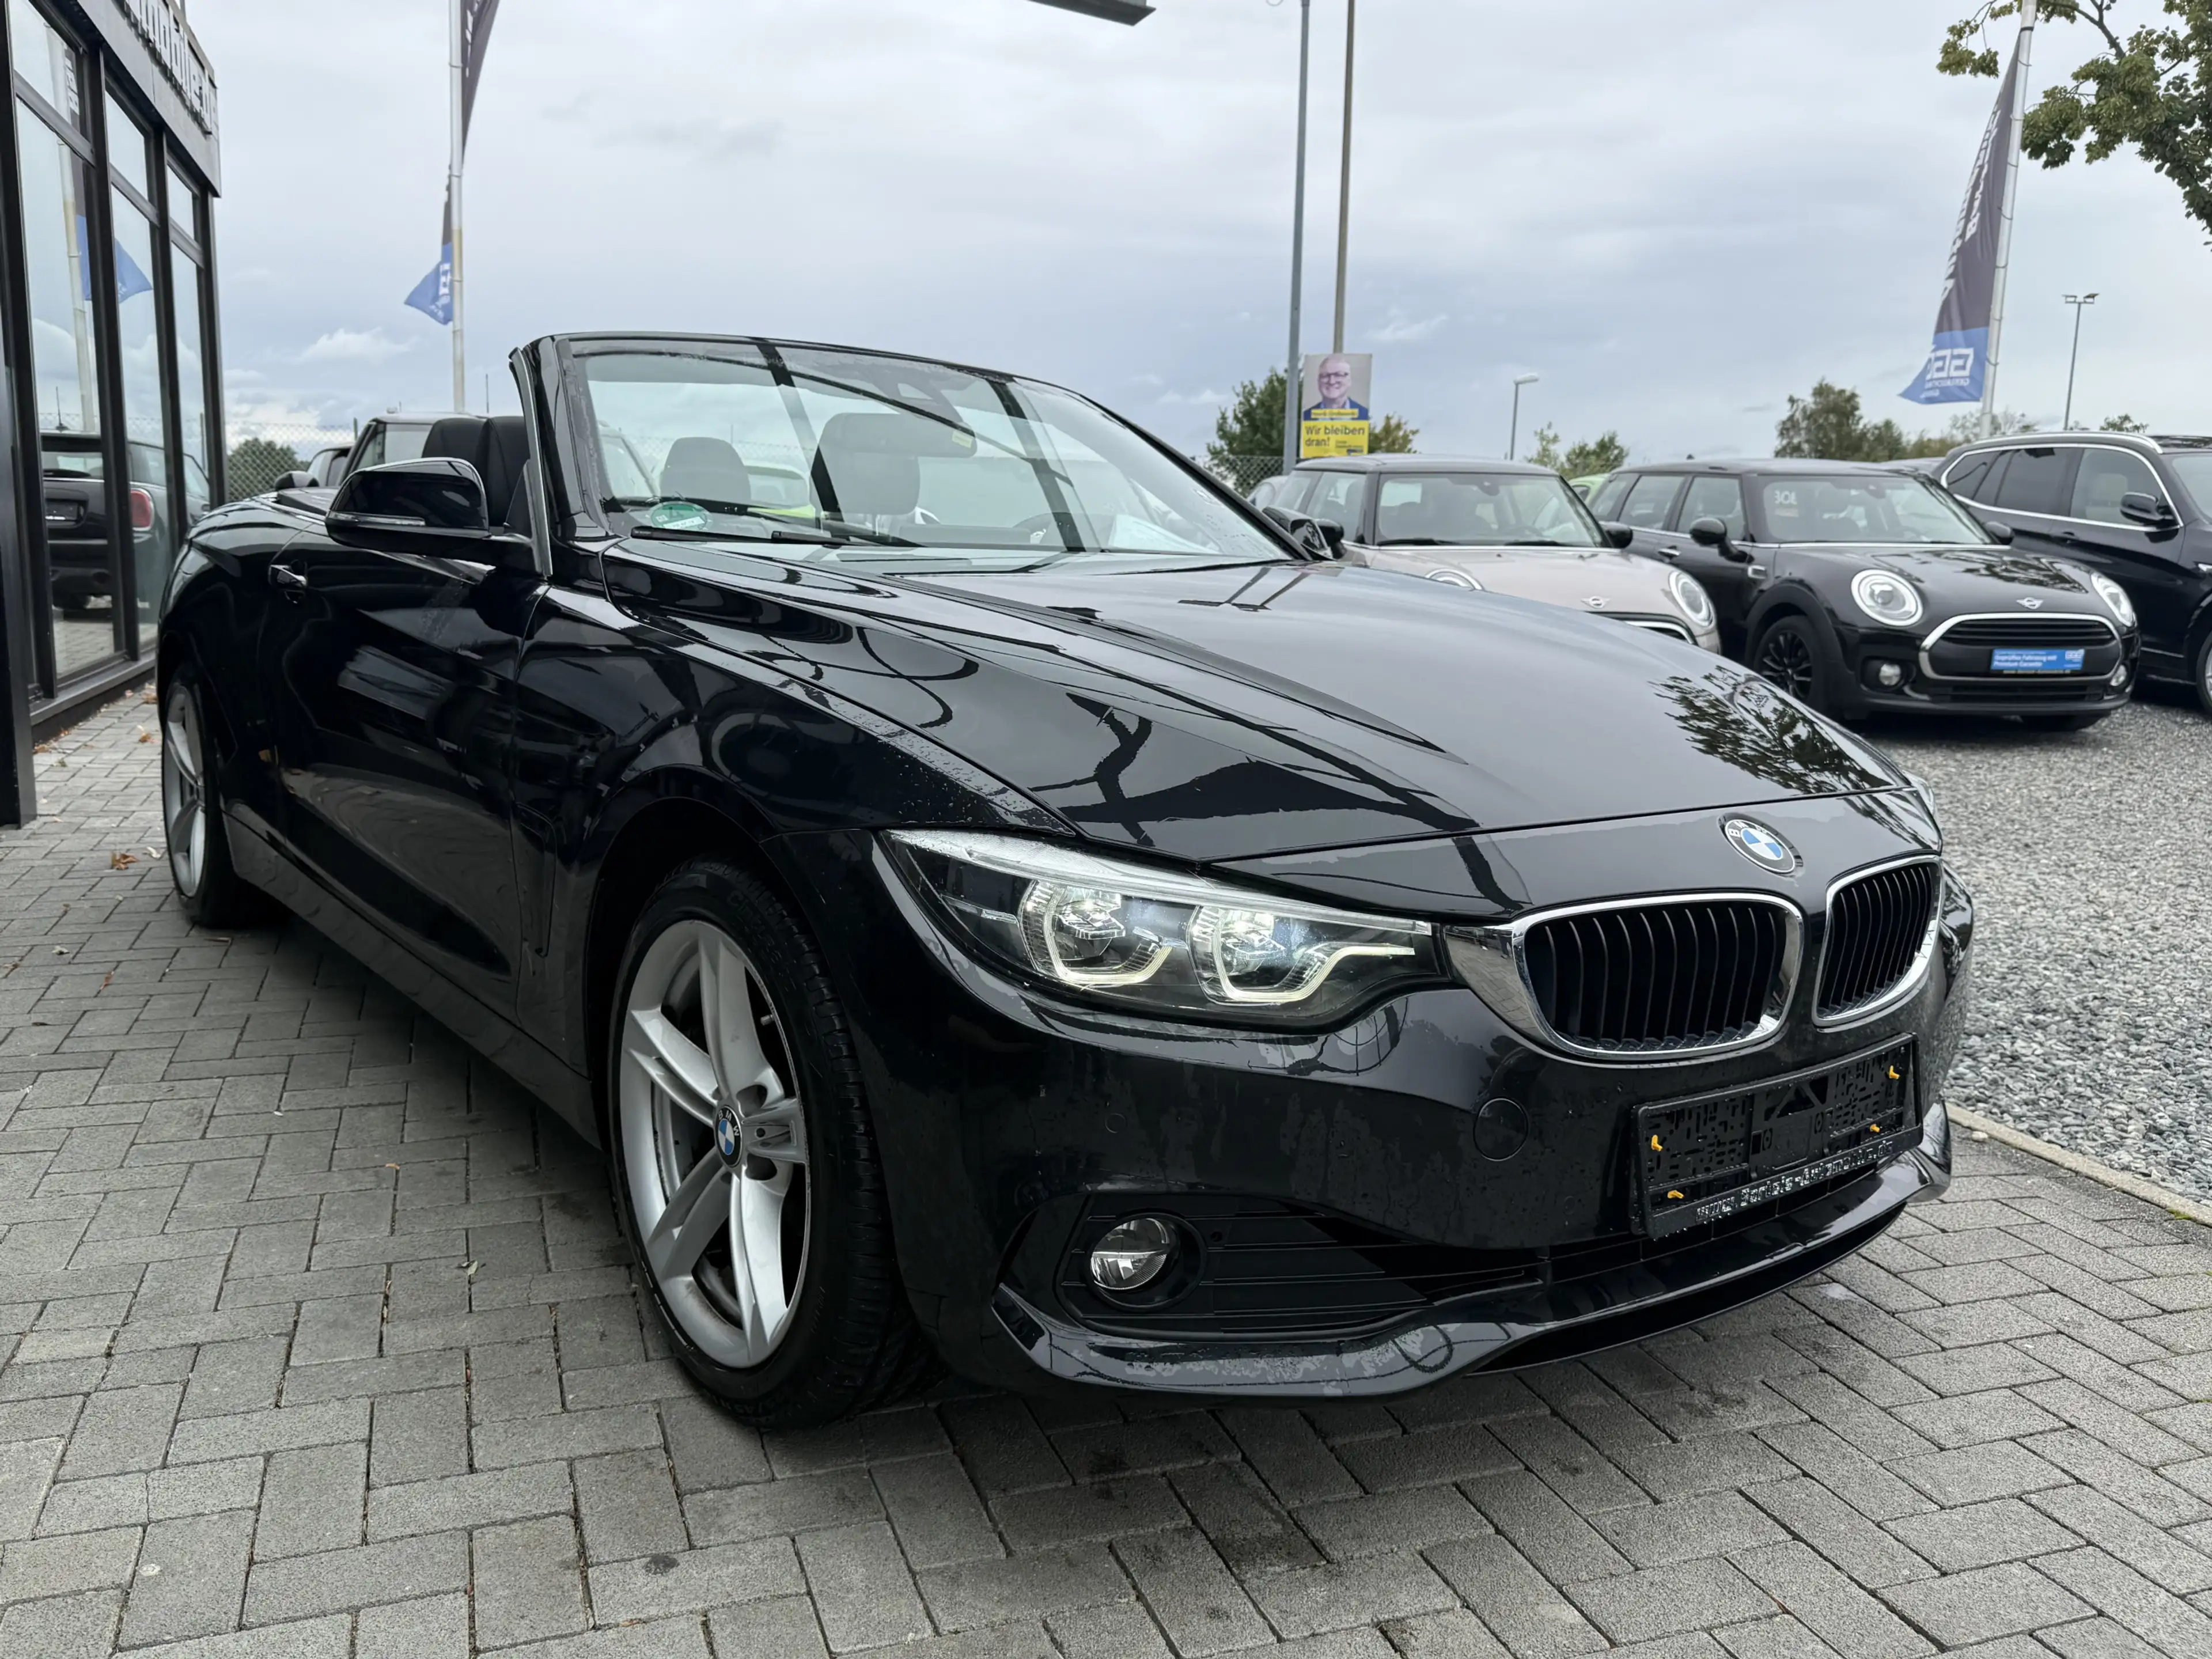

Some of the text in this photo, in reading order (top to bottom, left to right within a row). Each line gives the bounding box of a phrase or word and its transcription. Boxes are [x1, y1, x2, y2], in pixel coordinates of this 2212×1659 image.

[1305, 425, 1365, 435] Wir bleiben
[1305, 437, 1330, 447] dran!
[1728, 820, 1768, 838] BMW
[718, 1109, 740, 1136] BMW
